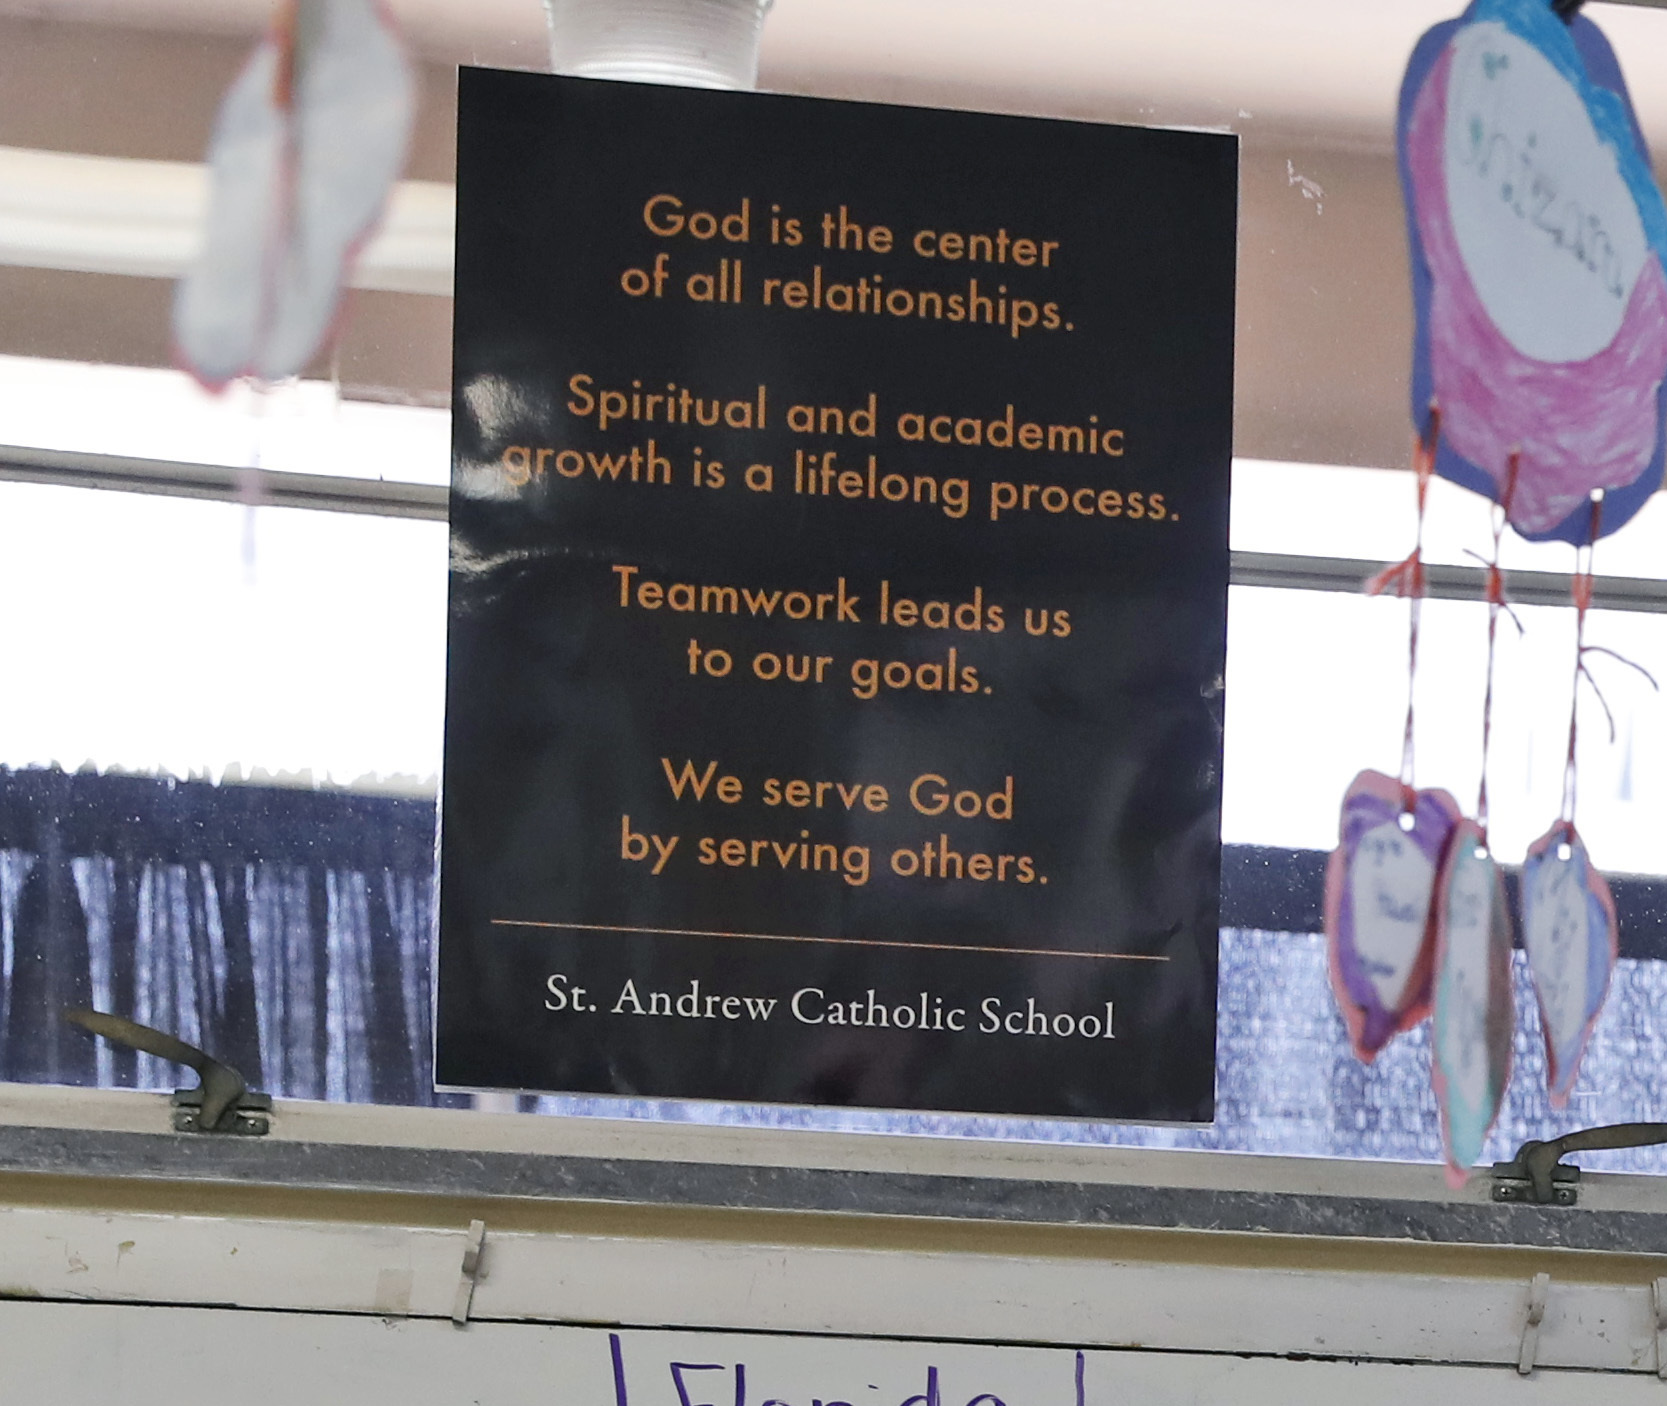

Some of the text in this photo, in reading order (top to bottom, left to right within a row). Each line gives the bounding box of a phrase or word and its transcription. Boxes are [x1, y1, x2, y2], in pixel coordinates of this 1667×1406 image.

[642, 193, 1060, 268] God is the center
[620, 252, 1075, 339] of all relationships.
[566, 372, 1125, 457] Spiritual and academic
[499, 438, 1180, 522] growth is a lifelong process.
[611, 564, 1073, 639] Teamwork leads us
[686, 637, 993, 701] to our goals.
[660, 756, 1015, 821] We serve God
[620, 813, 1049, 887] by serving others.
[543, 972, 1117, 1040] St. Andrew Catholic School
